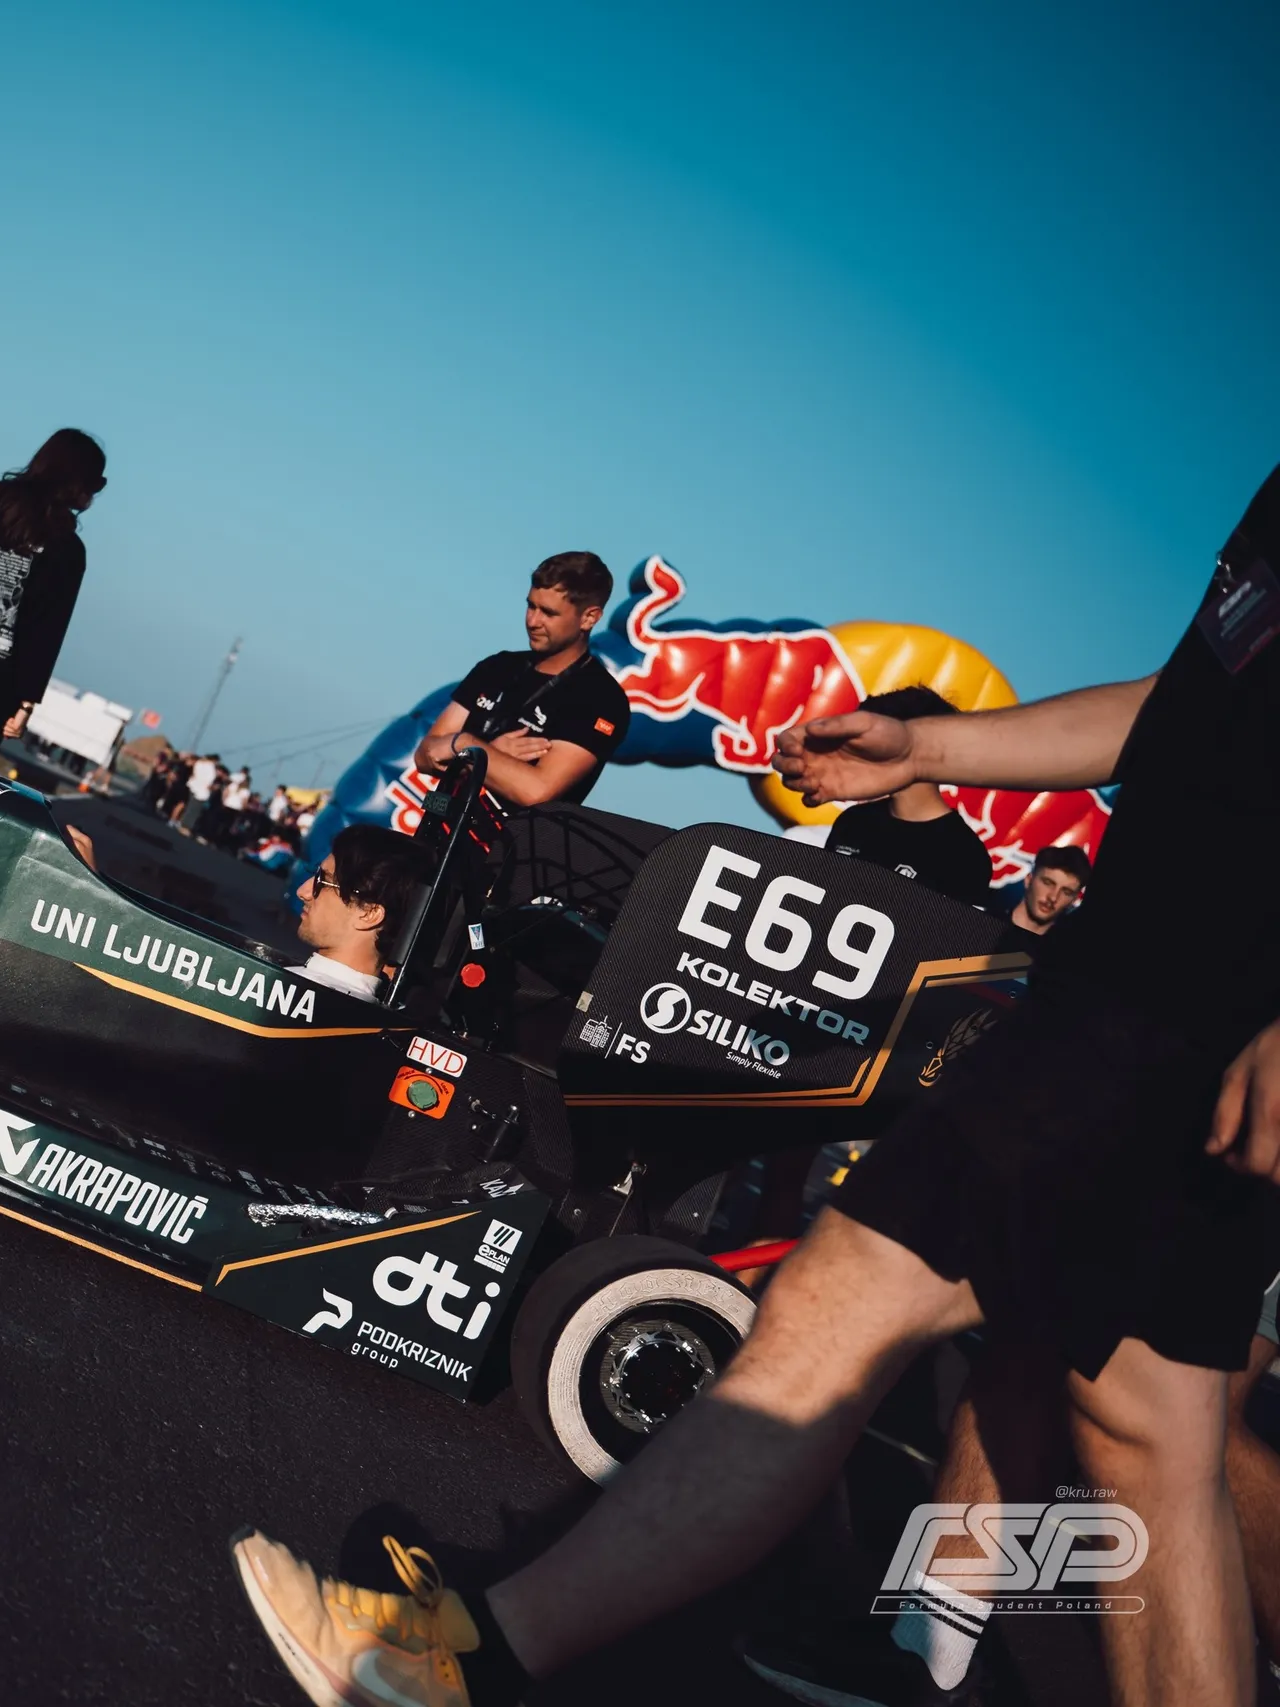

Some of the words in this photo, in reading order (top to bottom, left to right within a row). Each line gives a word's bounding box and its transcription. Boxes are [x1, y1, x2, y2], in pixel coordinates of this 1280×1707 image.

[677, 844, 895, 1001] E69
[29, 899, 93, 951] UNI
[103, 917, 317, 1023] LJUBLJANA
[676, 952, 870, 1046] KOLEKTOR
[408, 1037, 464, 1074] HVD
[615, 1033, 651, 1064] FS
[686, 1009, 790, 1066] SILIKO
[725, 1051, 753, 1069] Simply
[751, 1060, 782, 1080] Flexible
[372, 1251, 501, 1340] dti
[351, 1342, 399, 1369] group
[356, 1321, 473, 1382] PODKRIZNIK
